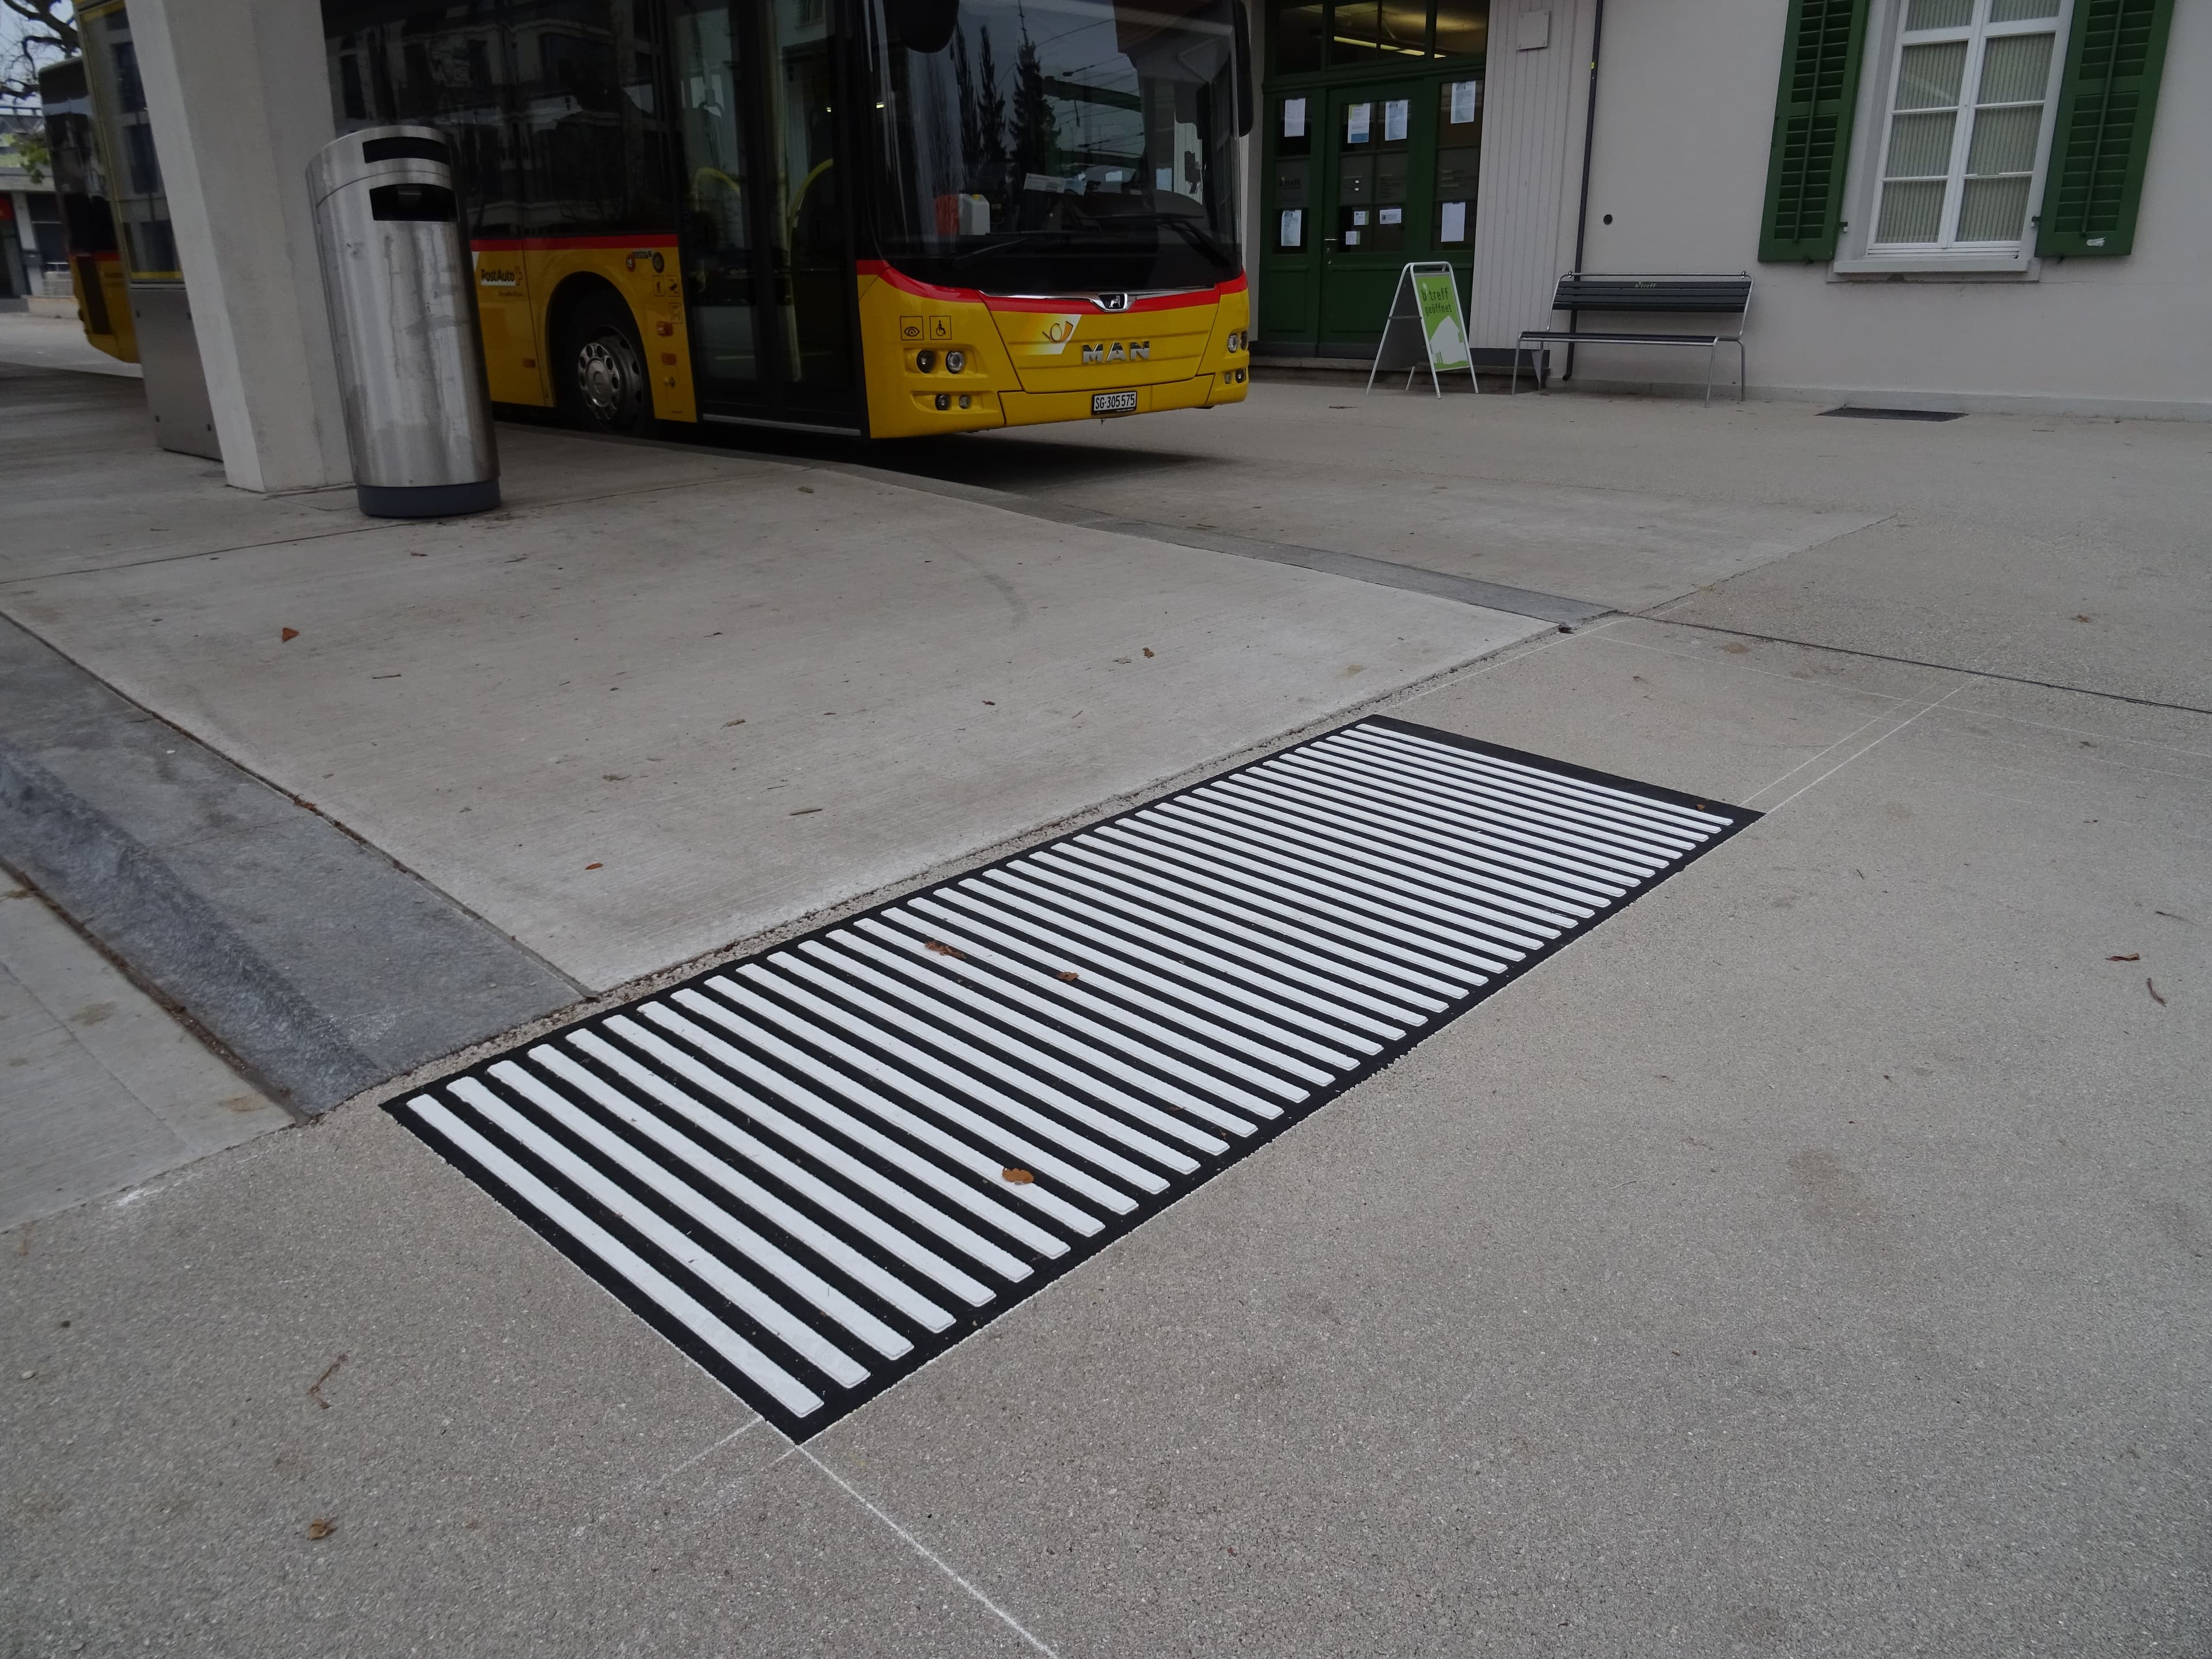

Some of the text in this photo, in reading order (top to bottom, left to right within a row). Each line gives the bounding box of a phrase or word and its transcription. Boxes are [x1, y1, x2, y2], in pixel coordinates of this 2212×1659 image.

[481, 268, 514, 282] PostAuto
[1425, 304, 1452, 316] geöffnet
[1082, 340, 1150, 363] MAN
